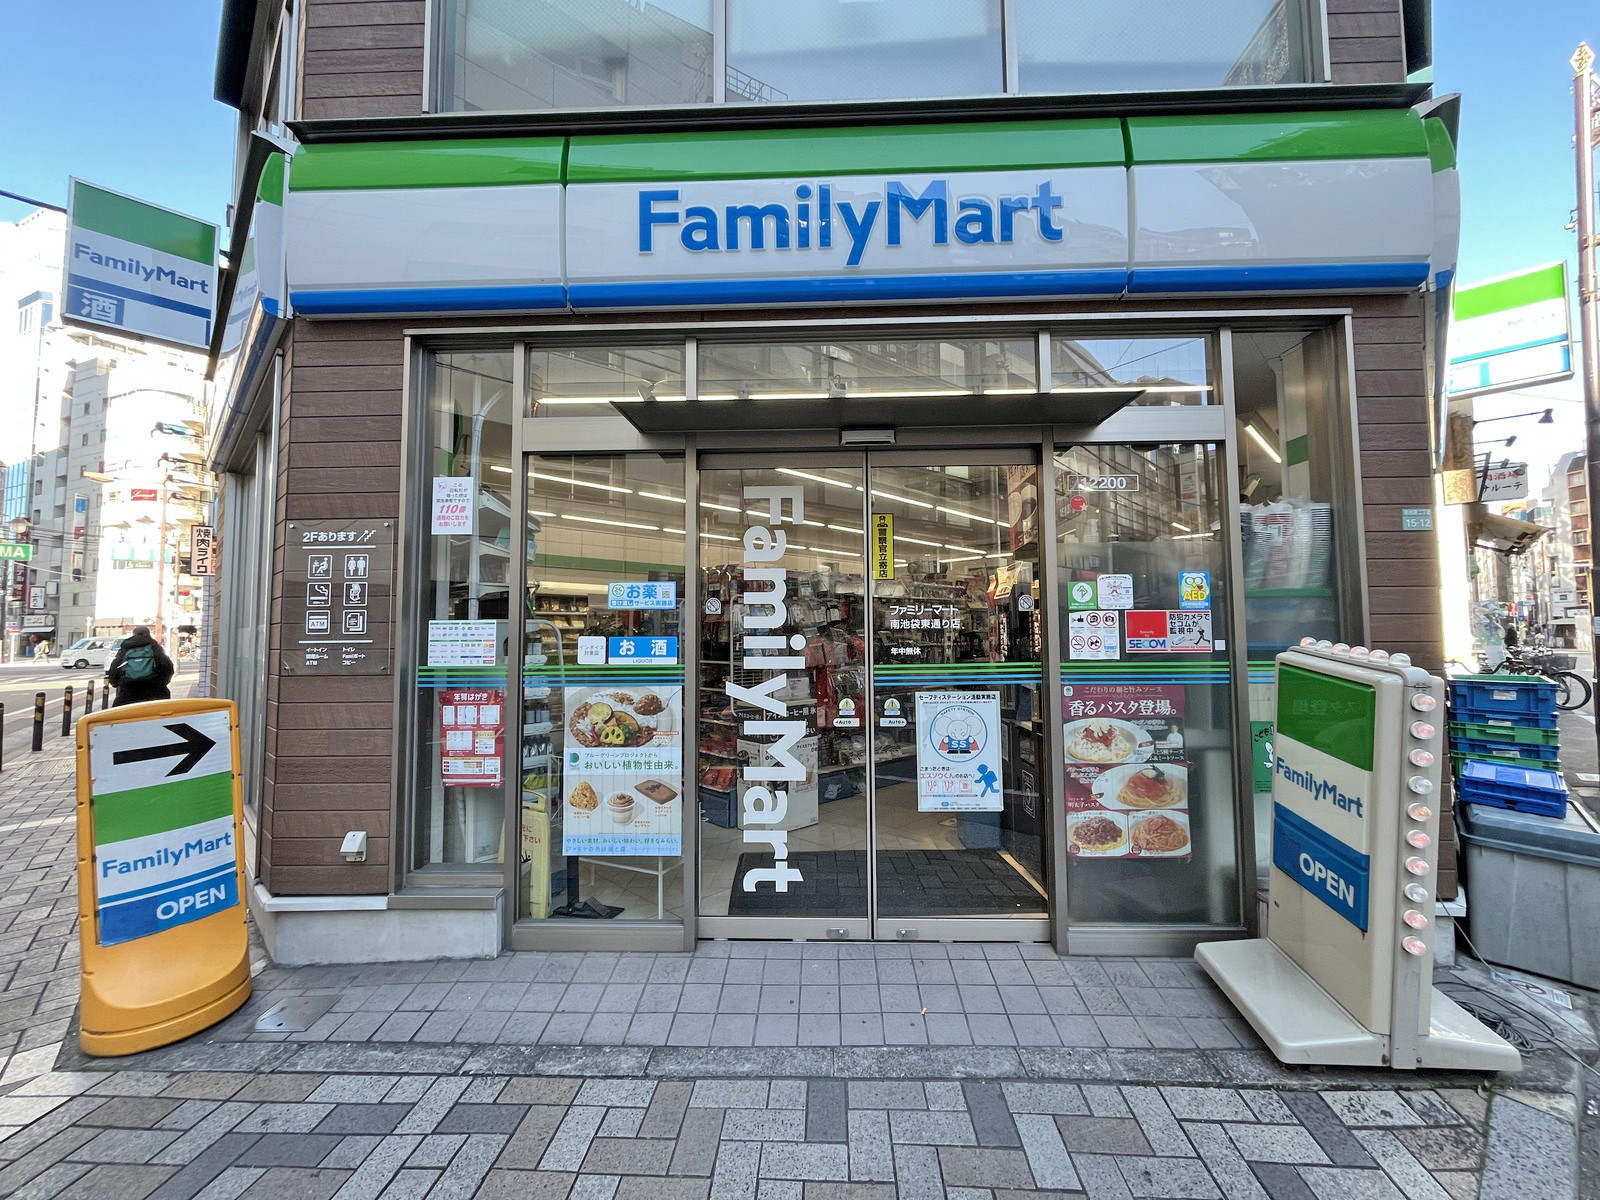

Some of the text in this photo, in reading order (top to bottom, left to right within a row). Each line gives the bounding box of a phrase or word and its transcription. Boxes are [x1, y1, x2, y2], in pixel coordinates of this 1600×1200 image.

[638, 179, 1064, 266] FamilyMart
[74, 243, 209, 294] FamilyMart
[80, 292, 118, 323] 酒
[439, 504, 467, 514] 110番
[1406, 519, 1431, 528] 15-12
[302, 531, 357, 543] 2Fあります
[878, 527, 888, 578] 警察官立寄店
[626, 584, 658, 599] お薬
[1183, 590, 1207, 601] AED
[889, 604, 959, 616] ファミリーマート
[1169, 613, 1210, 621] 防犯カメラで
[890, 618, 962, 630] 南池袋東通り店
[1170, 620, 1199, 628] セコムが
[1169, 627, 1194, 635] 監視中
[619, 639, 668, 656] お酒
[1128, 639, 1166, 649] SECOM
[890, 647, 922, 656] 年中無休
[725, 485, 807, 893] FamilyMart
[453, 693, 488, 701] 年賀はがき
[1068, 699, 1177, 717] 香るパスタ登場。
[951, 740, 967, 749] SS
[584, 759, 679, 771] おいしい植物性由来。
[1276, 757, 1364, 819] FamilyMart
[102, 832, 232, 878] FamilyMart
[1299, 852, 1355, 908] OPEN
[156, 884, 226, 920] OPEN
